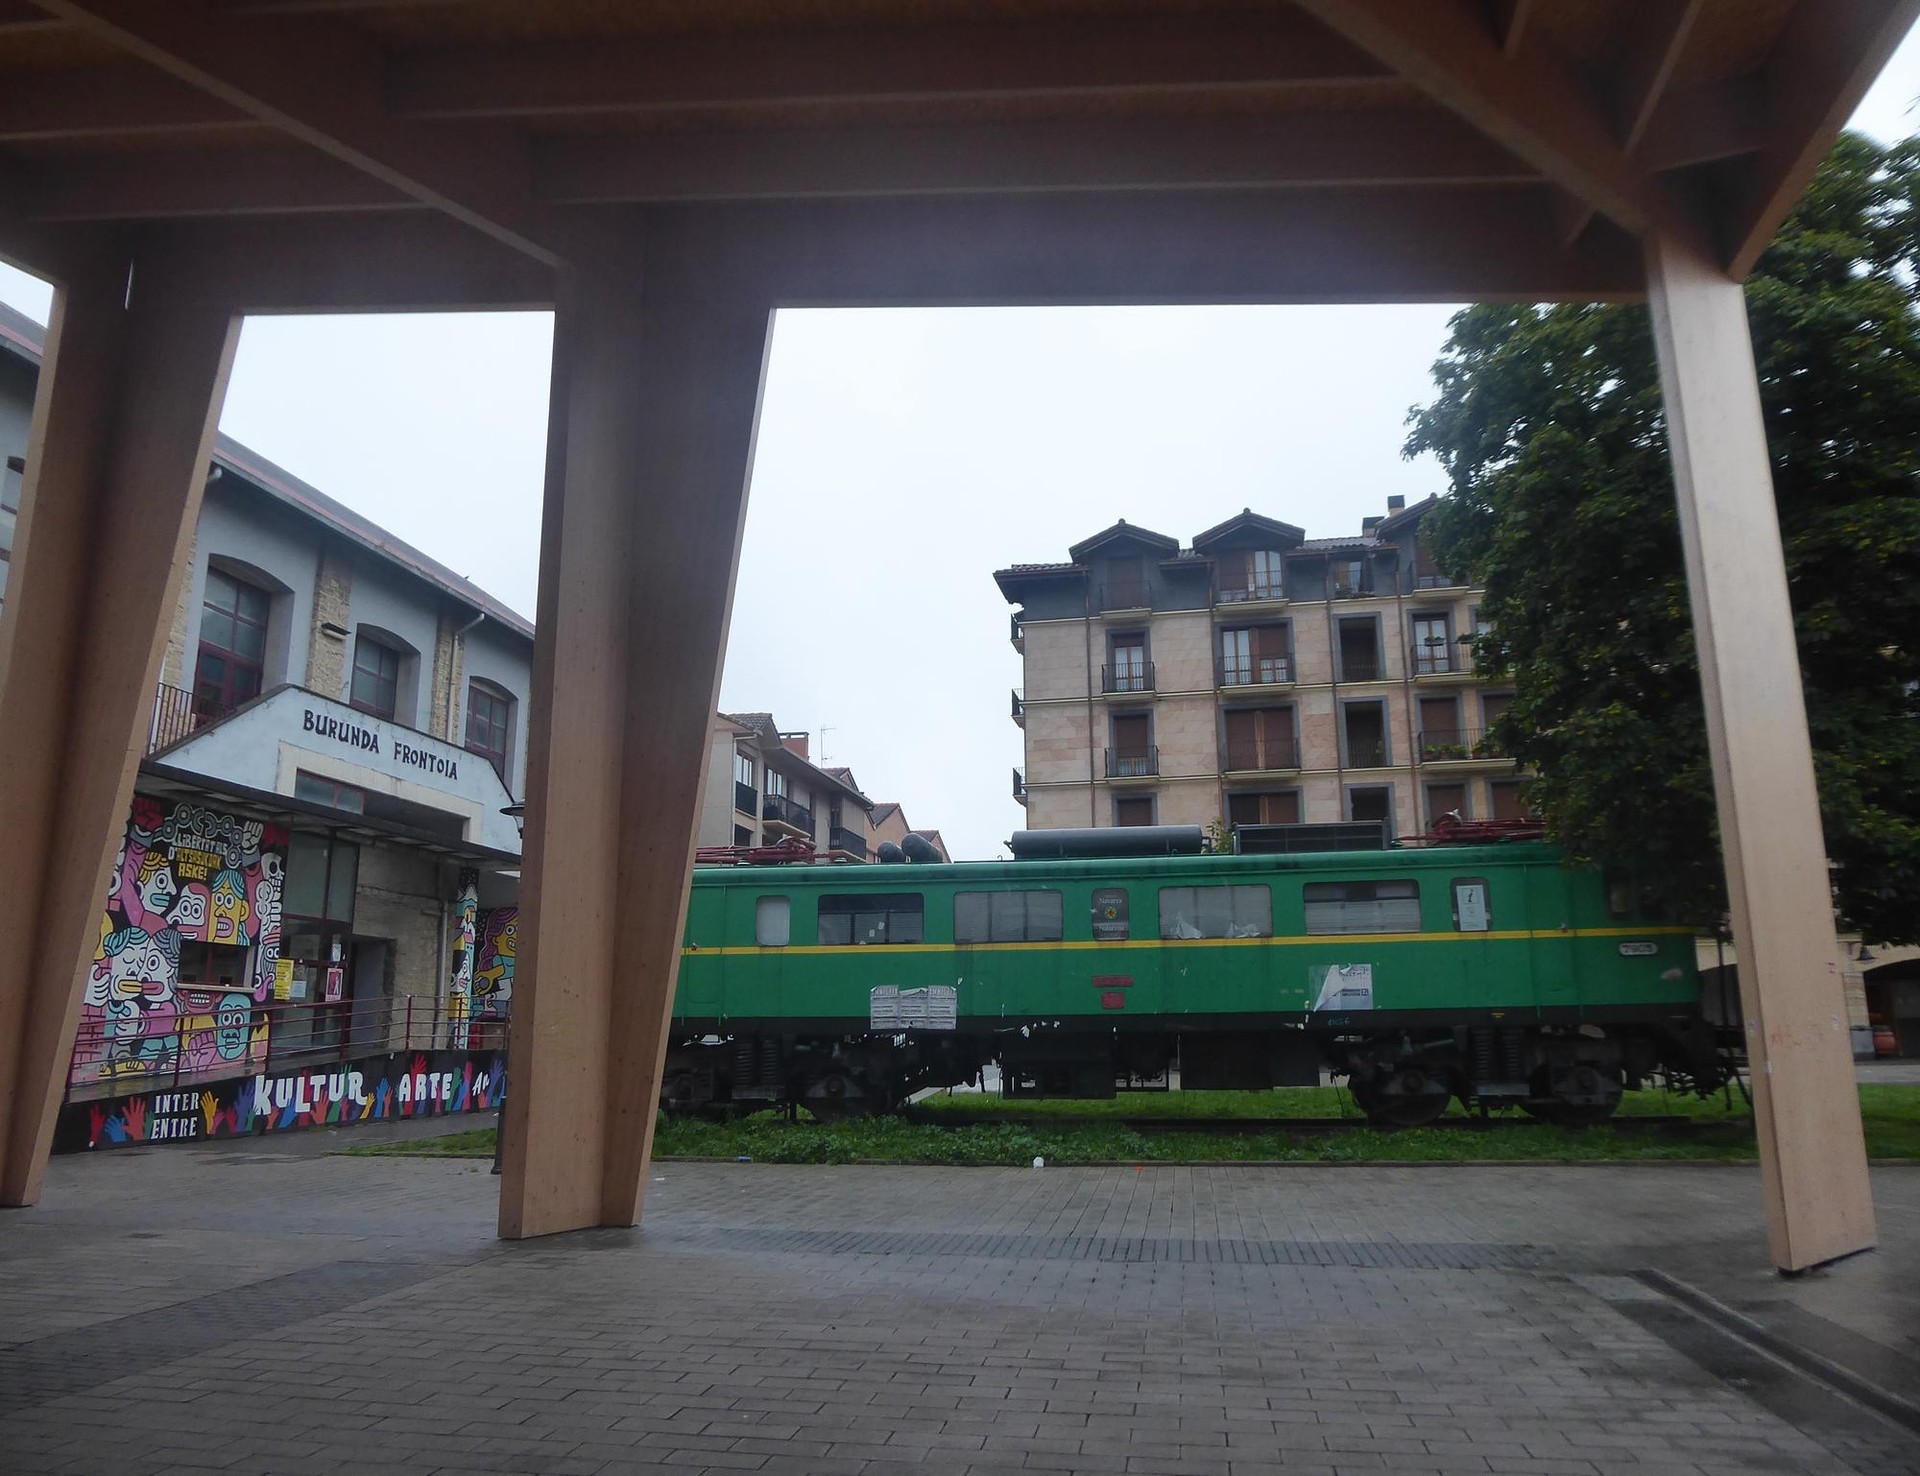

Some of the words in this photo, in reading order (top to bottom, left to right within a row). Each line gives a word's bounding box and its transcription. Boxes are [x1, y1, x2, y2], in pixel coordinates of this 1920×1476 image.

[303, 709, 379, 753] BURUNDA
[393, 742, 458, 780] FRONTOIA
[178, 863, 207, 880] ASKE!
[154, 1092, 200, 1114] INTER
[253, 1071, 368, 1116] KULTUR
[399, 1072, 453, 1102] ARTE
[150, 1117, 198, 1140] ENTRE
